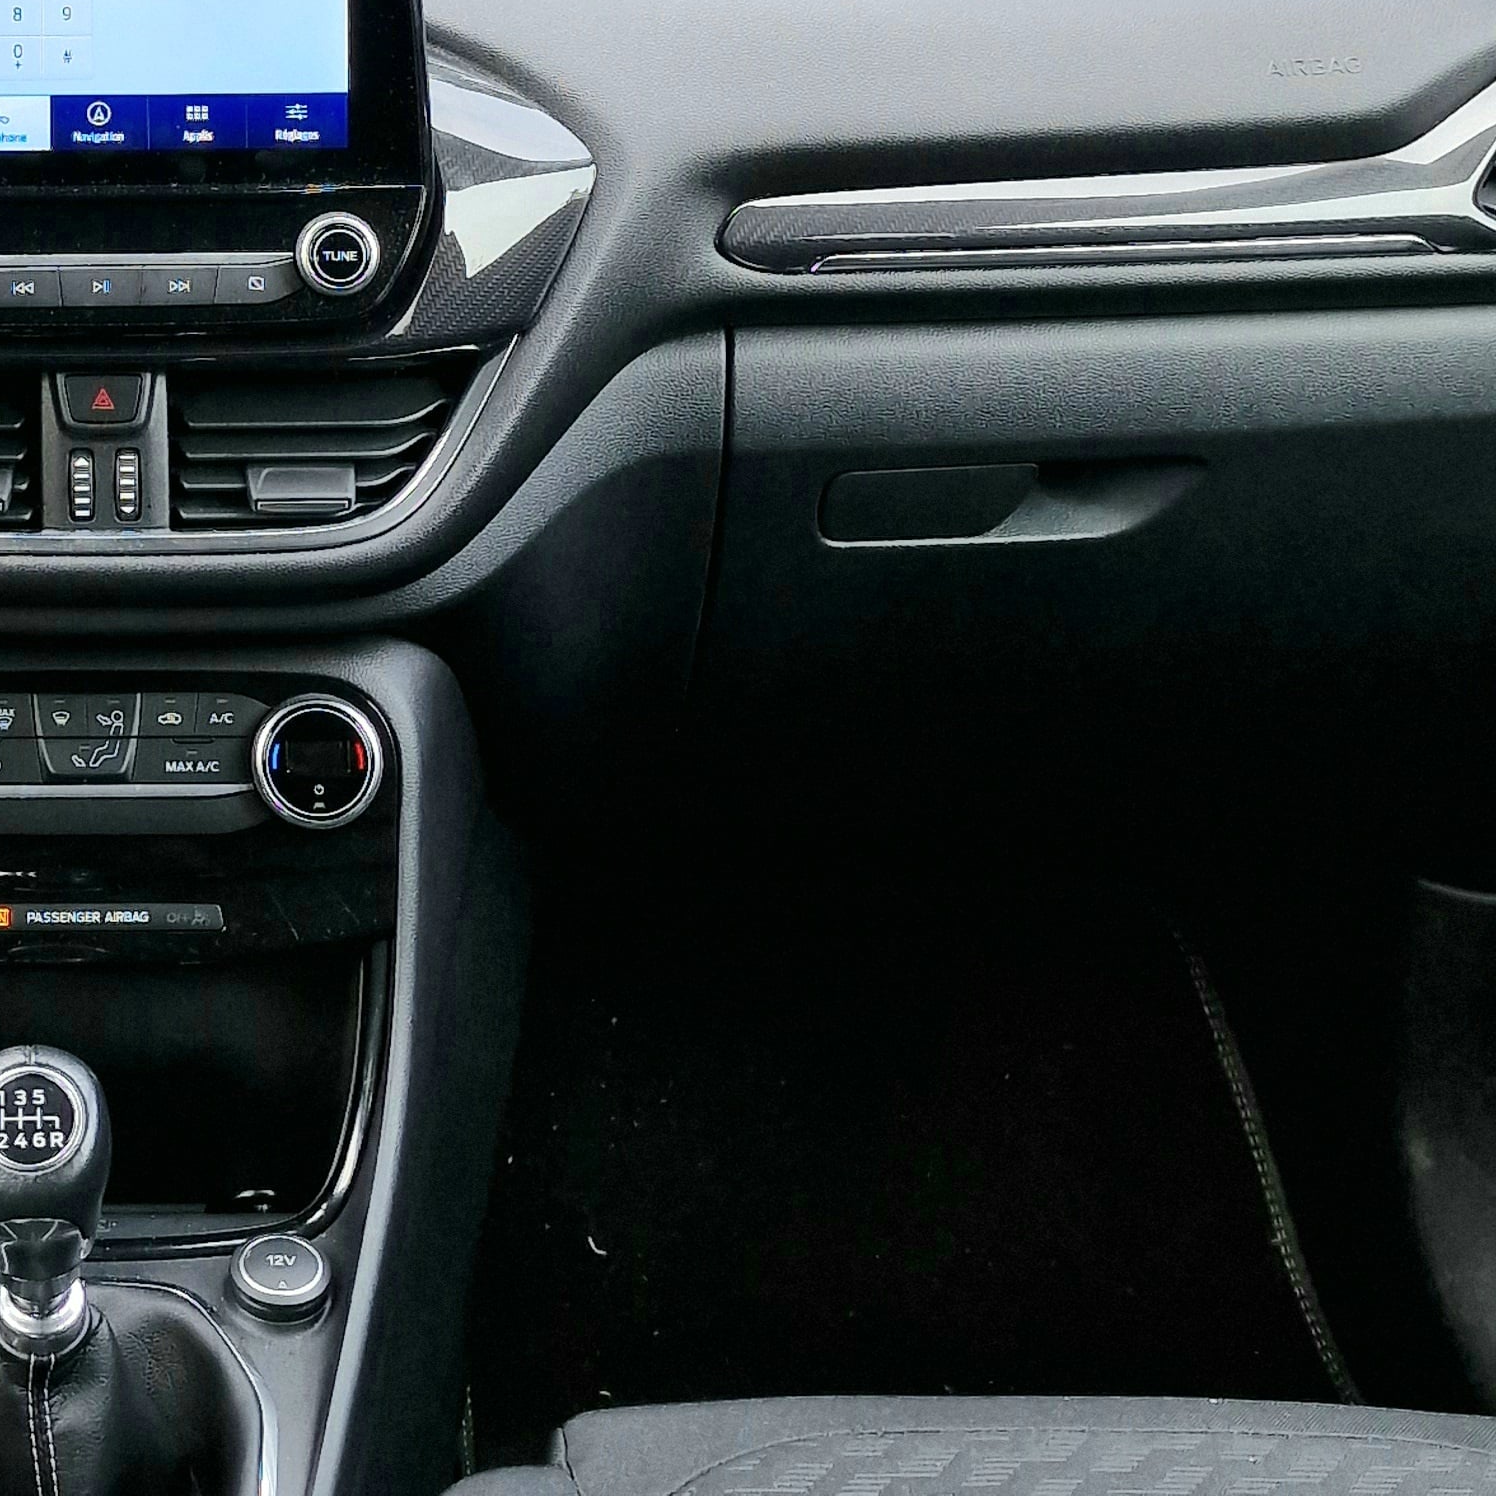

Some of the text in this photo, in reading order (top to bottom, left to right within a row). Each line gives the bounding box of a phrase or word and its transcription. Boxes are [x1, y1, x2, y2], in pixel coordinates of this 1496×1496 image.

[13, 7, 22, 21] 8
[62, 6, 71, 21] 9
[1267, 57, 1362, 78] AIRBAG
[72, 130, 125, 144] Navigation
[322, 250, 359, 262] TUNE
[209, 712, 235, 725] A/C
[165, 760, 221, 773] MAX A/C
[26, 911, 102, 924] PASSENGER
[104, 911, 151, 924] AIRBAG
[14, 1089, 27, 1106] 3
[32, 1089, 45, 1105] 5
[14, 1132, 28, 1149] 4
[32, 1131, 46, 1148] 6
[49, 1131, 64, 1148] R
[266, 1254, 297, 1266] 12V
